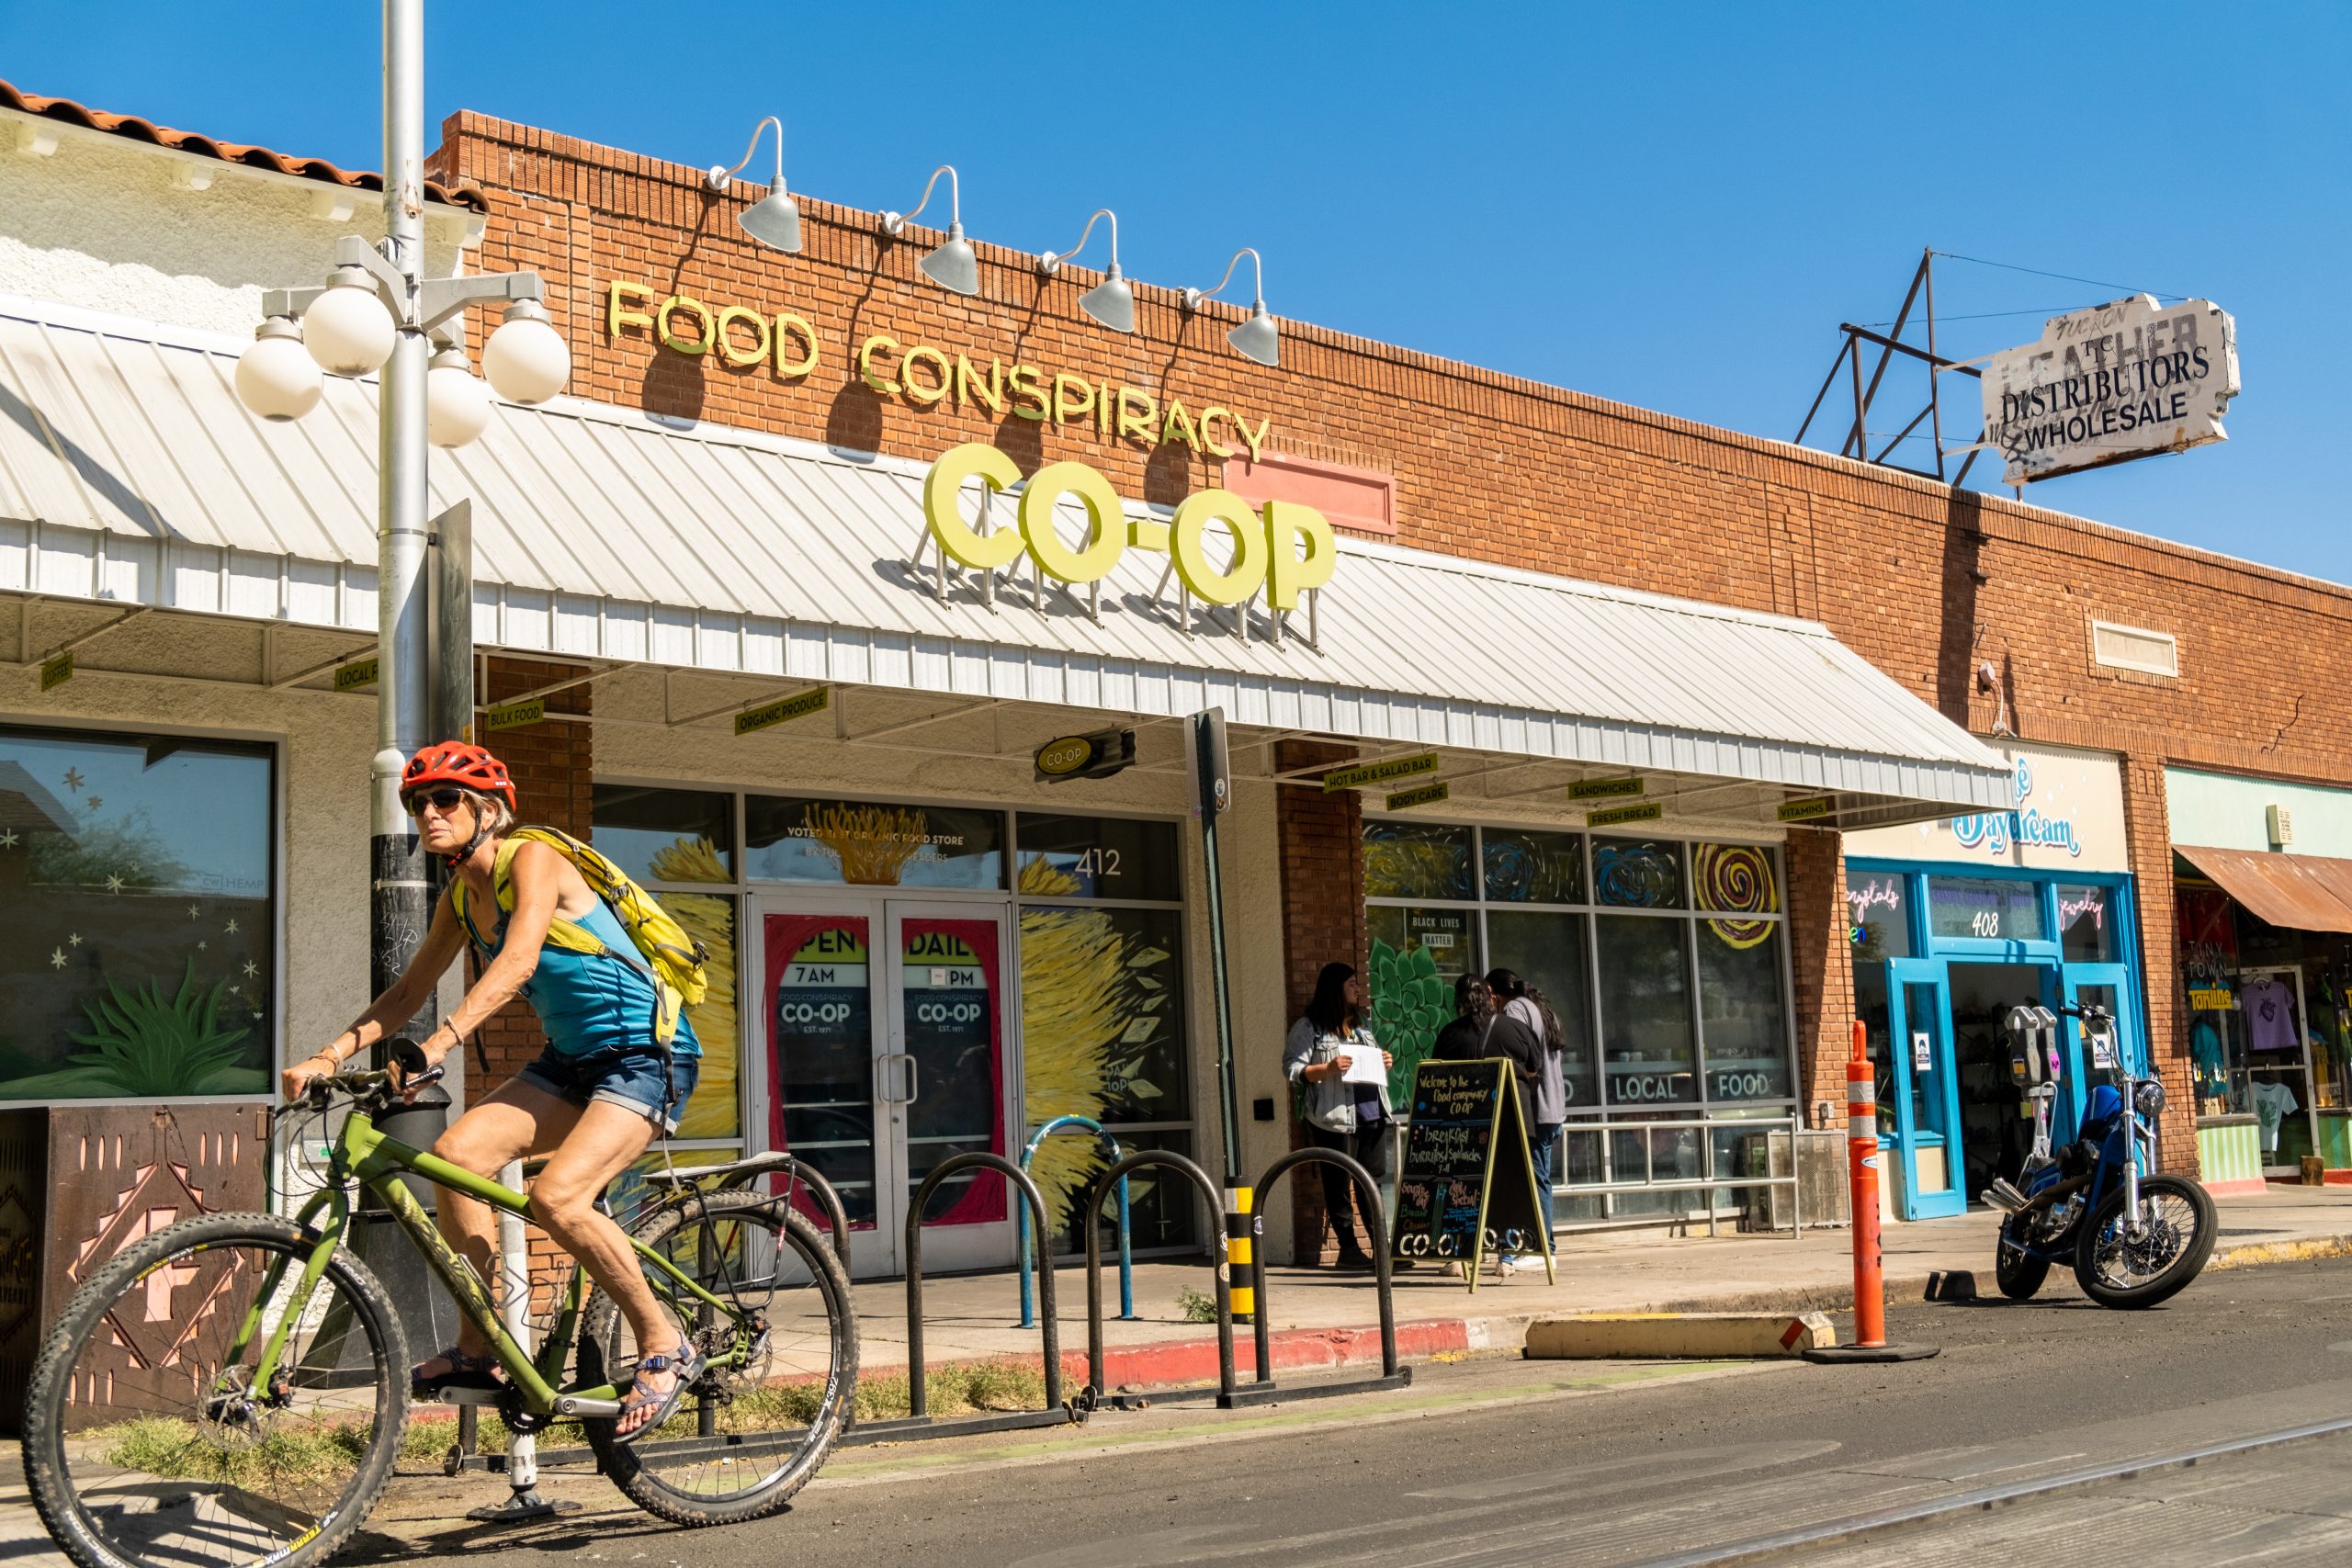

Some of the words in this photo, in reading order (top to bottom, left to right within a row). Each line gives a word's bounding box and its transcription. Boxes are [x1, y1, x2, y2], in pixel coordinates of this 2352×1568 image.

[610, 280, 818, 377] FOOD
[861, 334, 1271, 464] CONSPIRACY
[2001, 345, 2210, 425] DISTRIBUTORS
[2024, 391, 2188, 451] WHOLESALE
[923, 444, 1337, 609] CO-OP
[45, 661, 69, 684] COFFEE
[339, 667, 370, 686] LOCAL
[491, 708, 513, 726] BULK
[514, 706, 540, 721] FOOD
[740, 707, 780, 729] ORGANIC
[783, 693, 824, 716] PRODUCE
[1047, 748, 1081, 766] CO-OP
[1329, 774, 1351, 787] HOT
[1351, 772, 1368, 784] BAR
[1371, 769, 1377, 780] &
[1379, 763, 1410, 778] SALAD
[1412, 759, 1431, 771] BAR
[1390, 794, 1416, 808] BODY
[1418, 787, 1443, 801] CARE
[1574, 783, 1638, 796] SANDWICHES
[1592, 811, 1622, 824] FRESH
[1623, 807, 1656, 820] BREAD
[1781, 804, 1824, 817] VITAMINS
[787, 827, 823, 839] VOTED
[933, 835, 964, 846] STORE
[1951, 807, 2080, 854] Daydream
[1074, 847, 1121, 879] 412
[226, 877, 265, 889] HEMP
[2059, 889, 2103, 931] jewelry
[1412, 917, 1436, 927] BLACK
[1441, 918, 1460, 928] LIVES
[1972, 911, 1999, 938] 408
[799, 929, 855, 953] PEN
[909, 932, 979, 956] DAIL
[1424, 934, 1452, 946] MATTER
[1849, 926, 1866, 942] en
[2188, 941, 2222, 957] TINY
[950, 970, 974, 986] PM
[2188, 962, 2228, 978] TOWN
[781, 1003, 851, 1023] CO-OP
[917, 1003, 981, 1022] CO-OP
[1615, 1076, 1679, 1100] LOCAL
[1718, 1073, 1770, 1098] FOOD
[823, 1377, 839, 1410] X392
